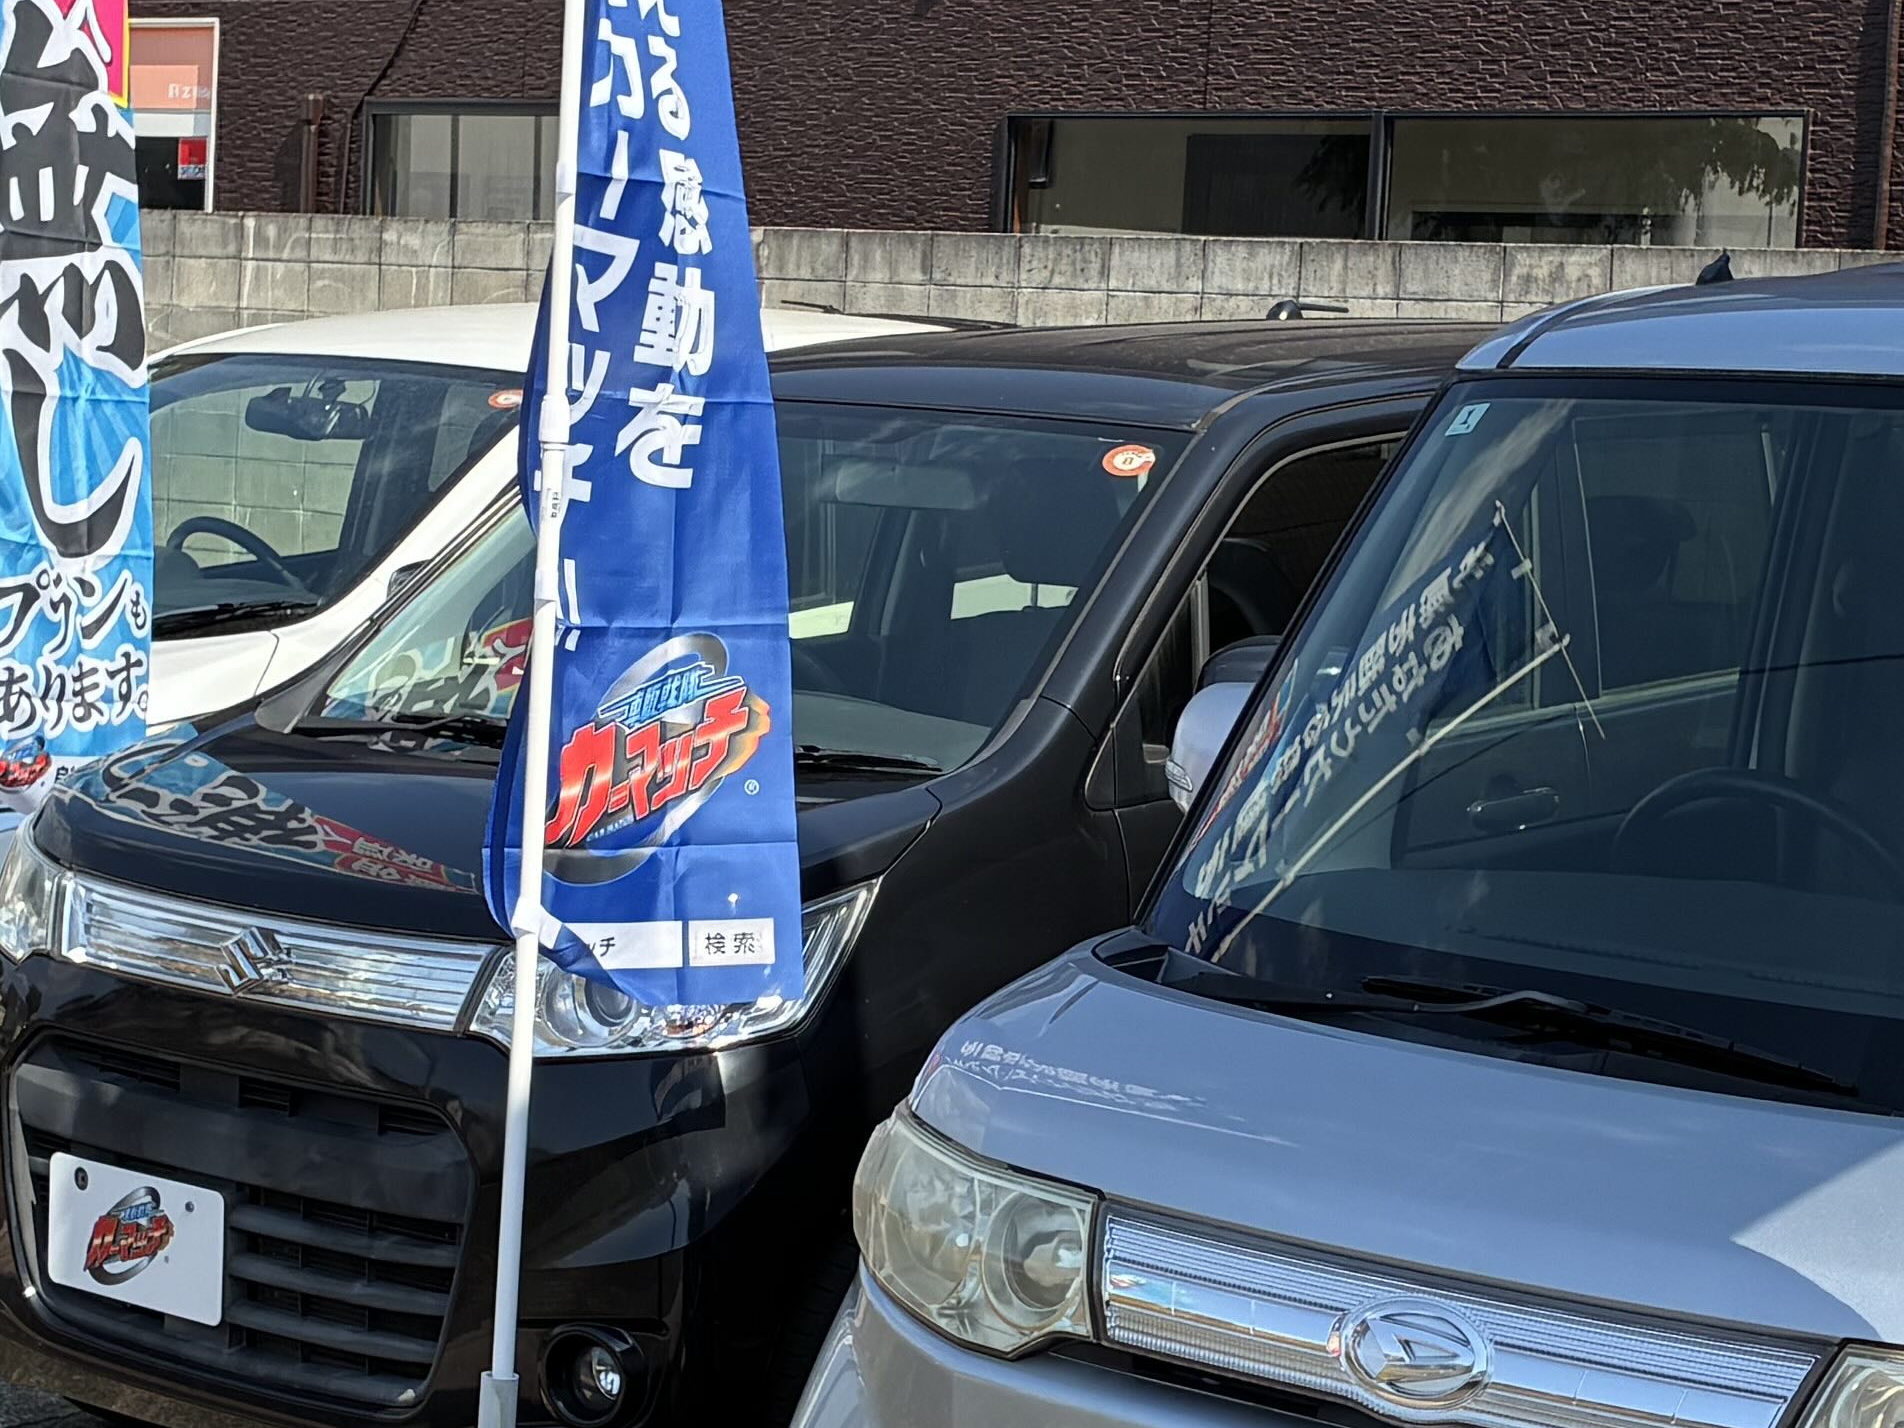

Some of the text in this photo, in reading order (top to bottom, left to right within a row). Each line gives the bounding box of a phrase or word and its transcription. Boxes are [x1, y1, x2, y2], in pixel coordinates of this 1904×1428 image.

[543, 687, 749, 849] カーマッチ
[704, 932, 757, 955] 検索
